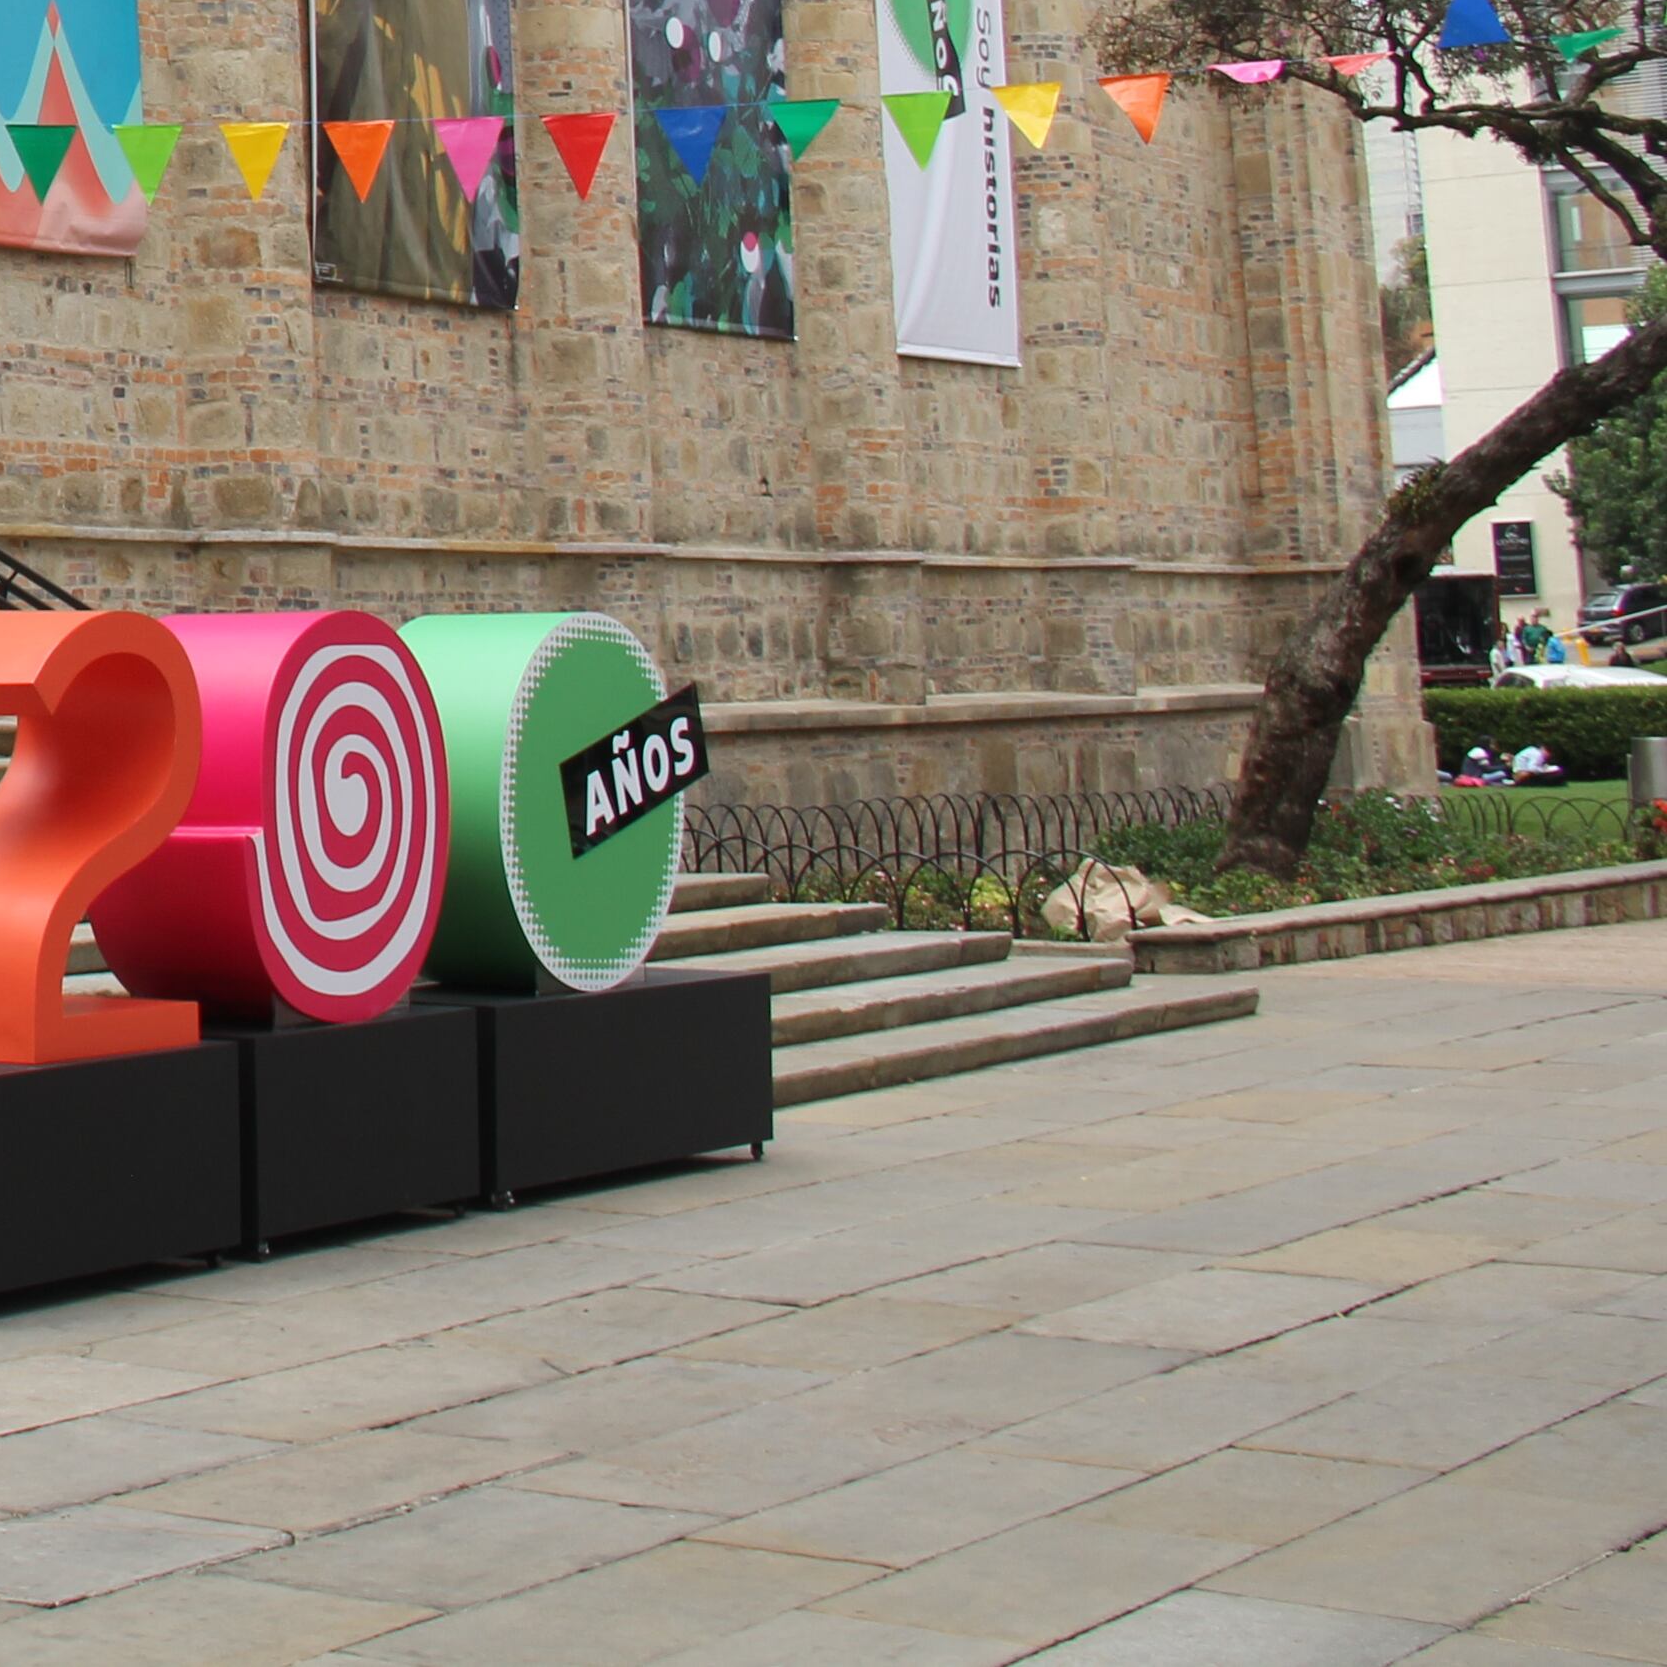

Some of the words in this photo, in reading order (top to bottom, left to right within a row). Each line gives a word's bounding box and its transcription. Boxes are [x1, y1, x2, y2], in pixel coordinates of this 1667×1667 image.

[976, 7, 992, 90] Soy
[981, 105, 1003, 310] historias
[585, 714, 695, 837] AÑOS
